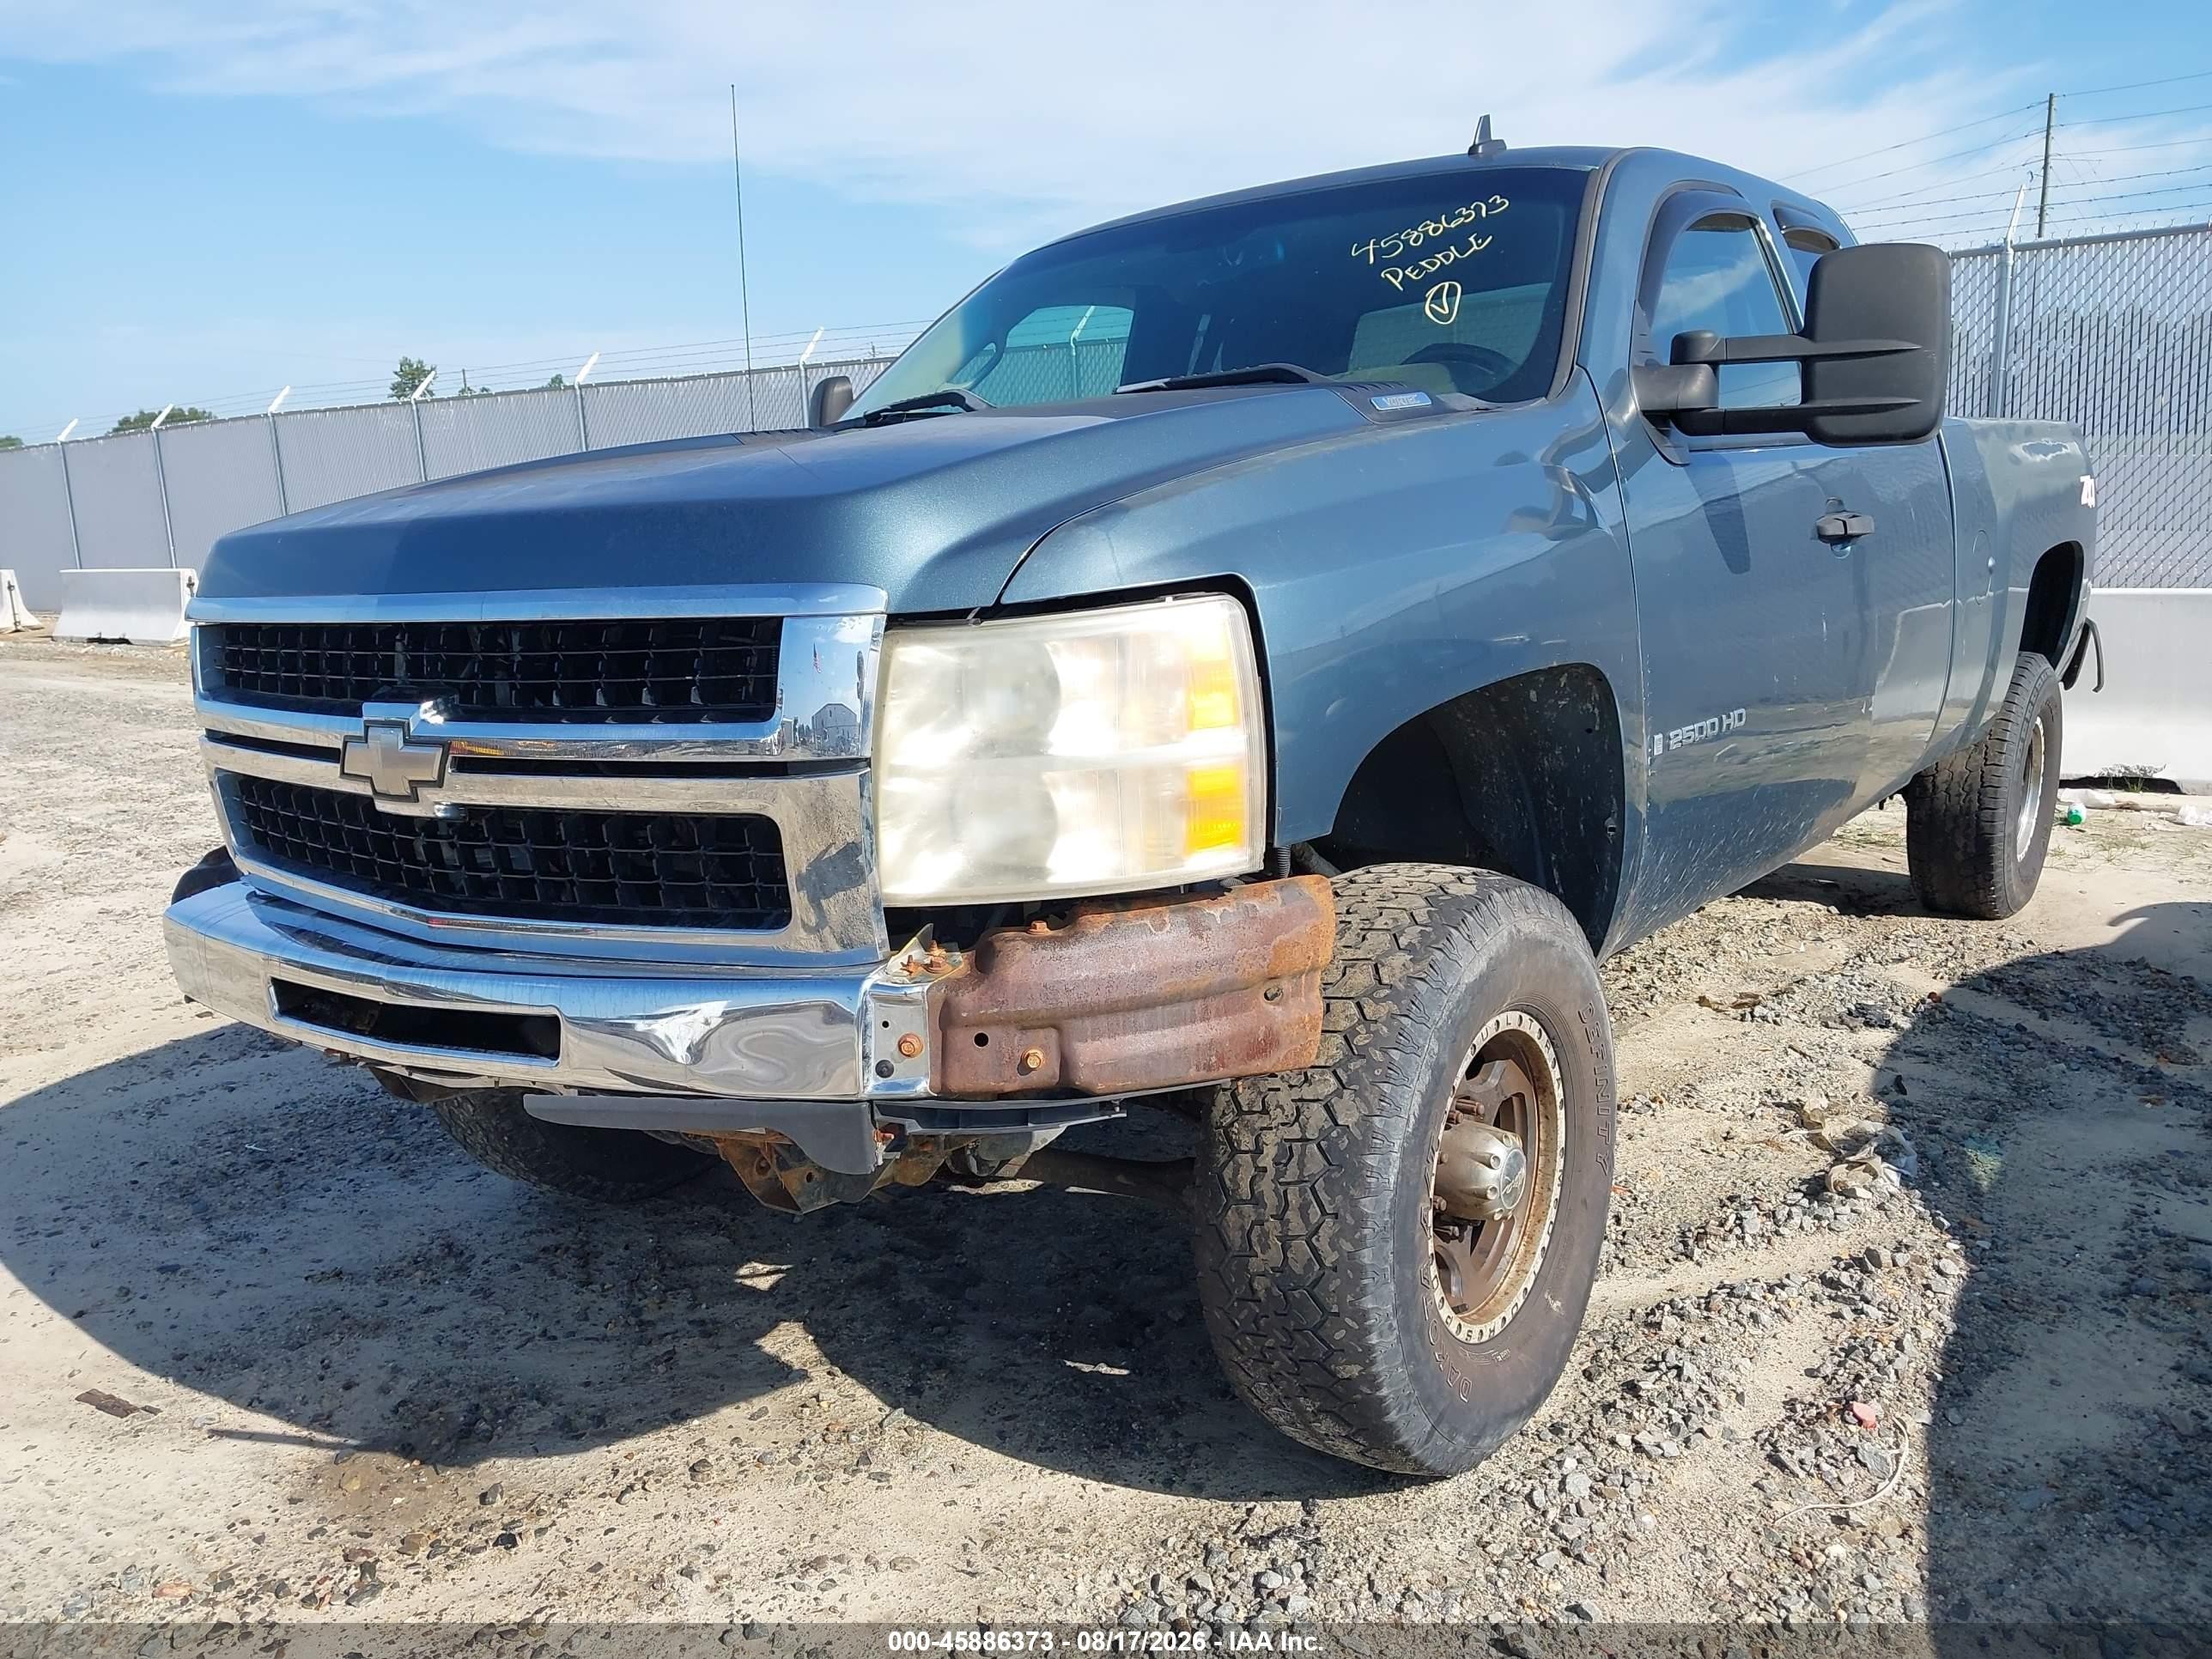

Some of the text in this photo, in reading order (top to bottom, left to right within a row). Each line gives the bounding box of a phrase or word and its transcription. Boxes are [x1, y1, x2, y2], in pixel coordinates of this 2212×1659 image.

[1351, 195, 1509, 264] 45886373
[1381, 233, 1492, 292] PEDDLE
[1668, 708, 1747, 751] 2500 HD
[1577, 1001, 1611, 1176] DEFINITY
